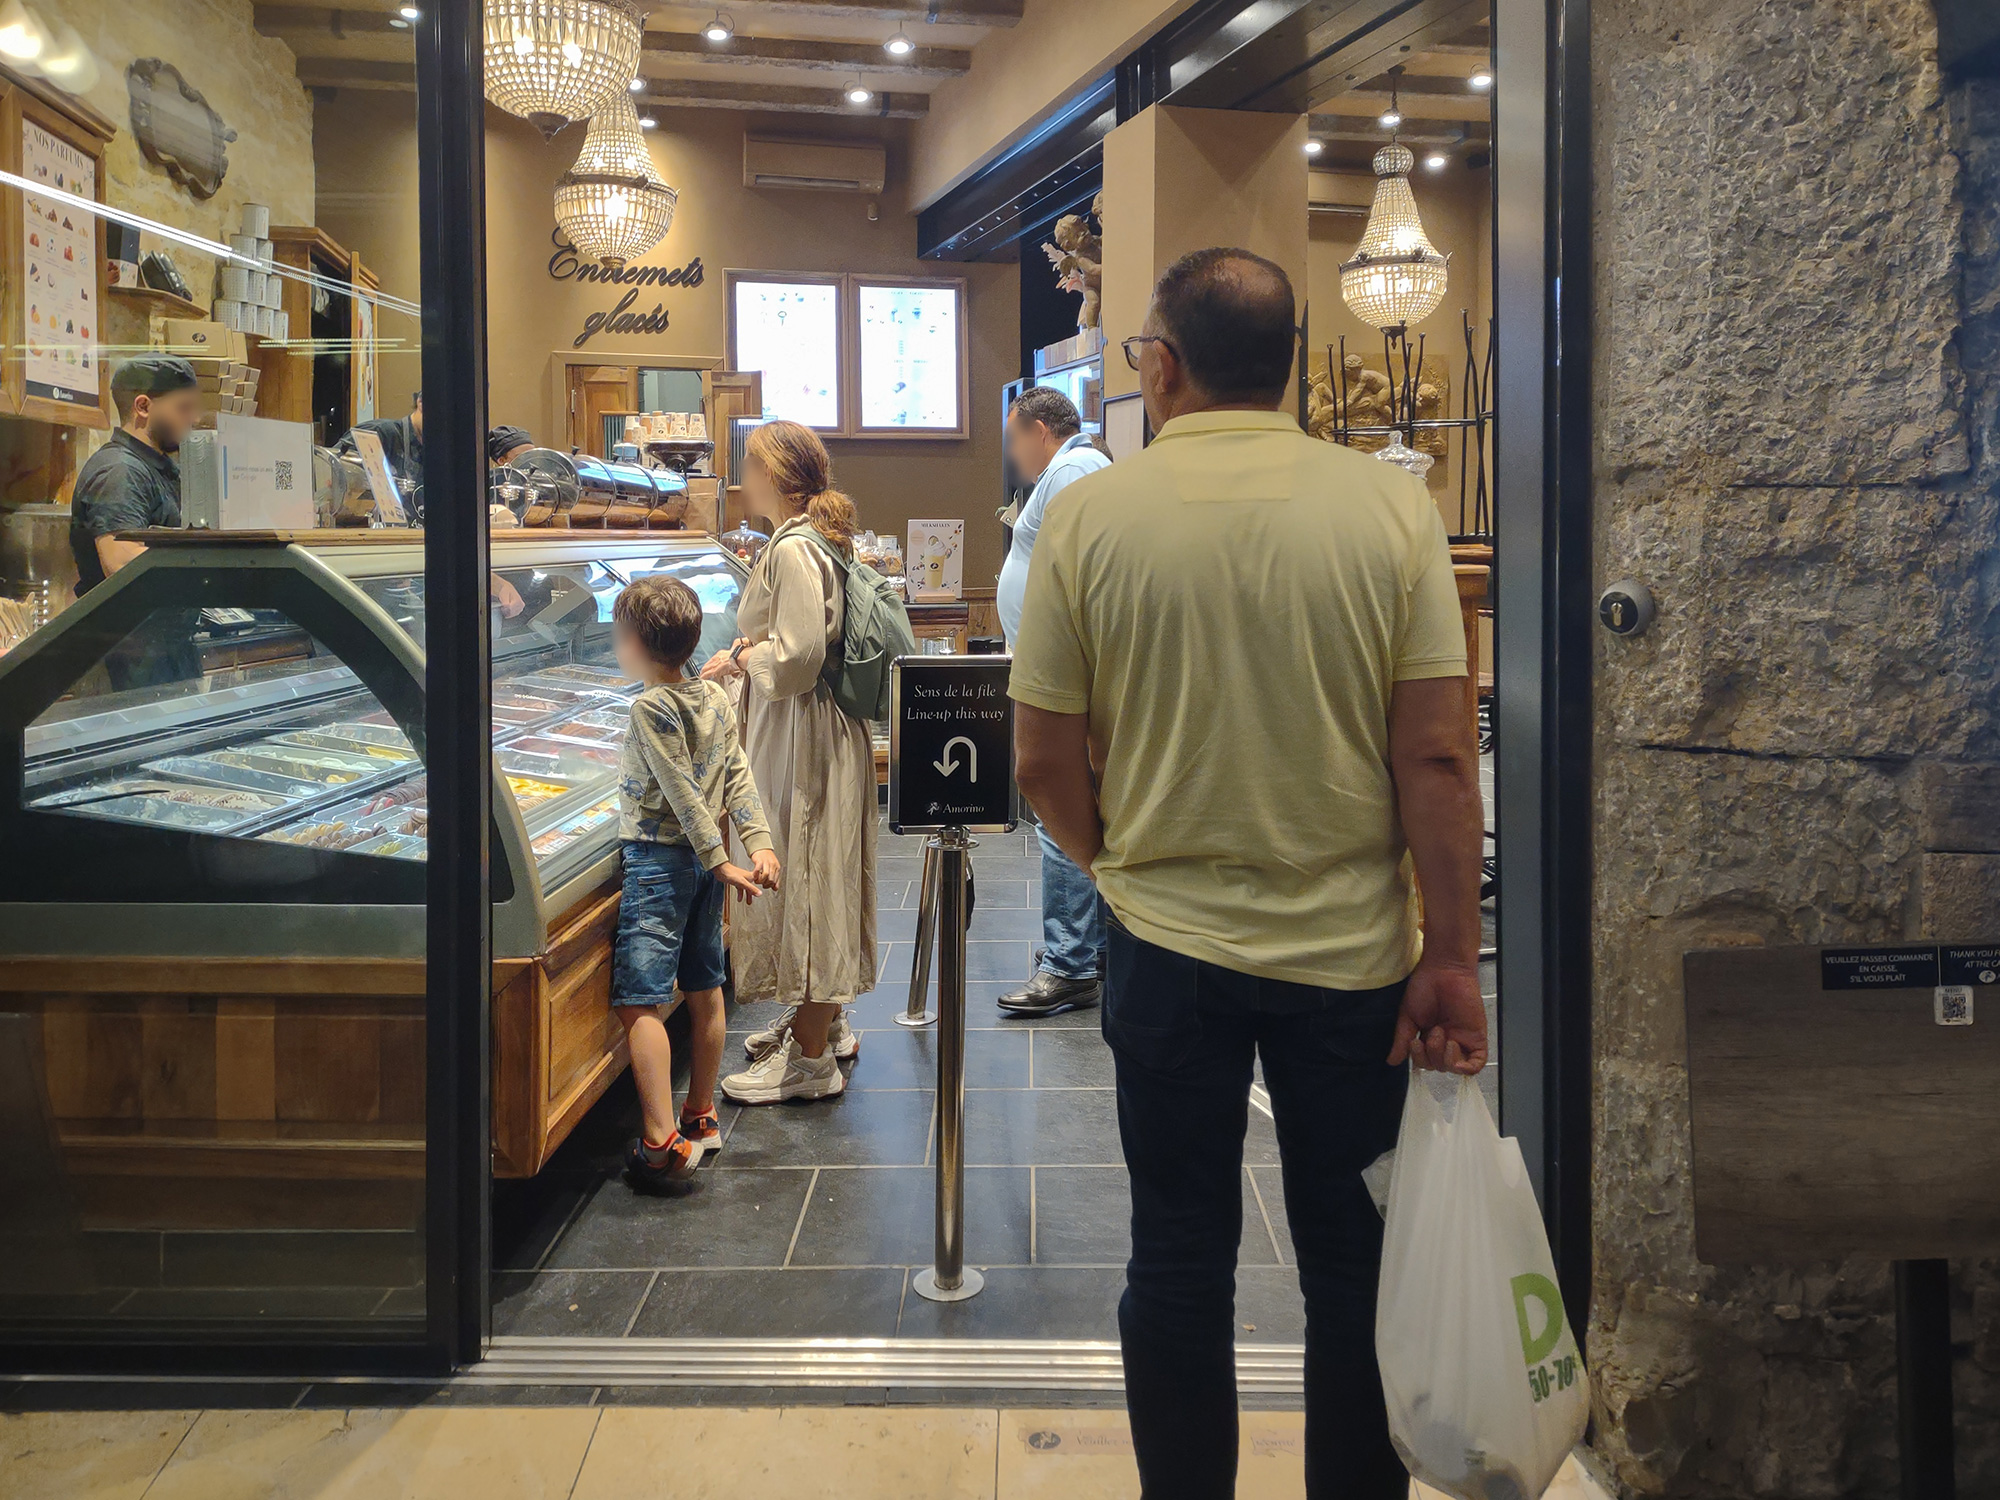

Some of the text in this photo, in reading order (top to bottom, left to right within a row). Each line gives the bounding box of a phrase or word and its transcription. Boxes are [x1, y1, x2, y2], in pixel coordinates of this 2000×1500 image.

[33, 128, 84, 170] NOS PARFUMS
[573, 287, 669, 348] glacés
[914, 683, 996, 700] Sens de la file
[907, 706, 1004, 722] Line-up this way
[943, 803, 985, 814] Amorino
[1825, 952, 1934, 965] VEUILLEZ PASSER COMMANDE
[1950, 950, 1975, 959] THANK
[1976, 950, 1994, 958] YOU
[1859, 965, 1869, 973] EN
[1964, 960, 1975, 969] AT
[1975, 959, 1990, 968] THE
[1850, 974, 1863, 984] S'IL
[1864, 974, 1885, 983] VOUS
